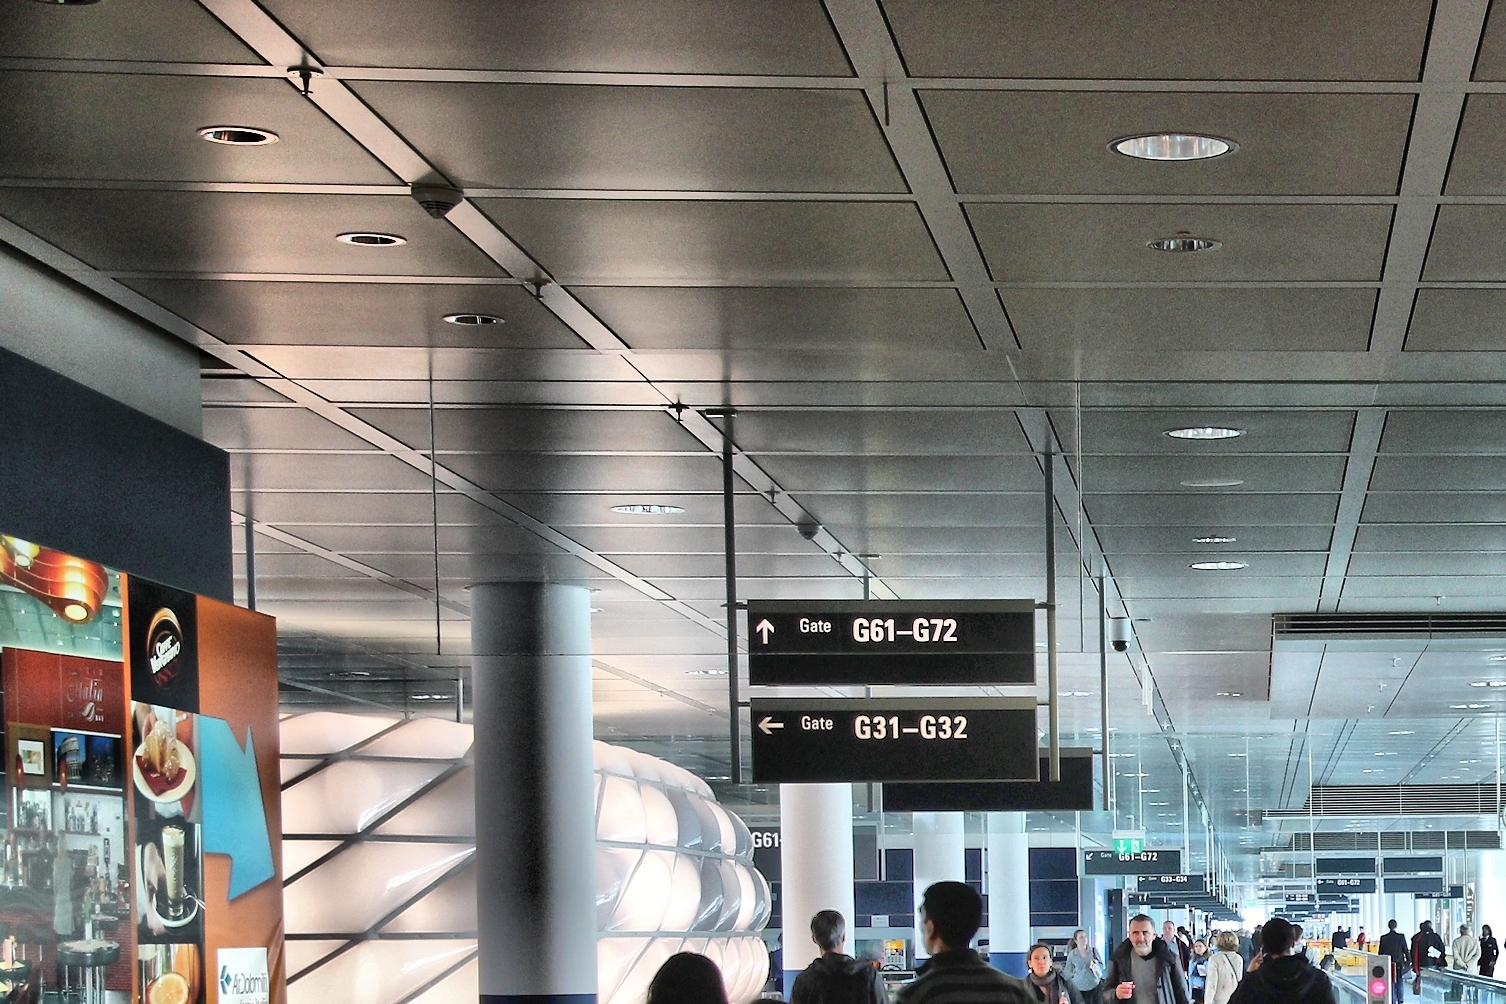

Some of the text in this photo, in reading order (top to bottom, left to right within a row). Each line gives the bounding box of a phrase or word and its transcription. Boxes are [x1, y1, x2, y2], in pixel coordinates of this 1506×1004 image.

[799, 618, 832, 633] Gate
[801, 715, 834, 731] Gate
[752, 831, 781, 848] G61
